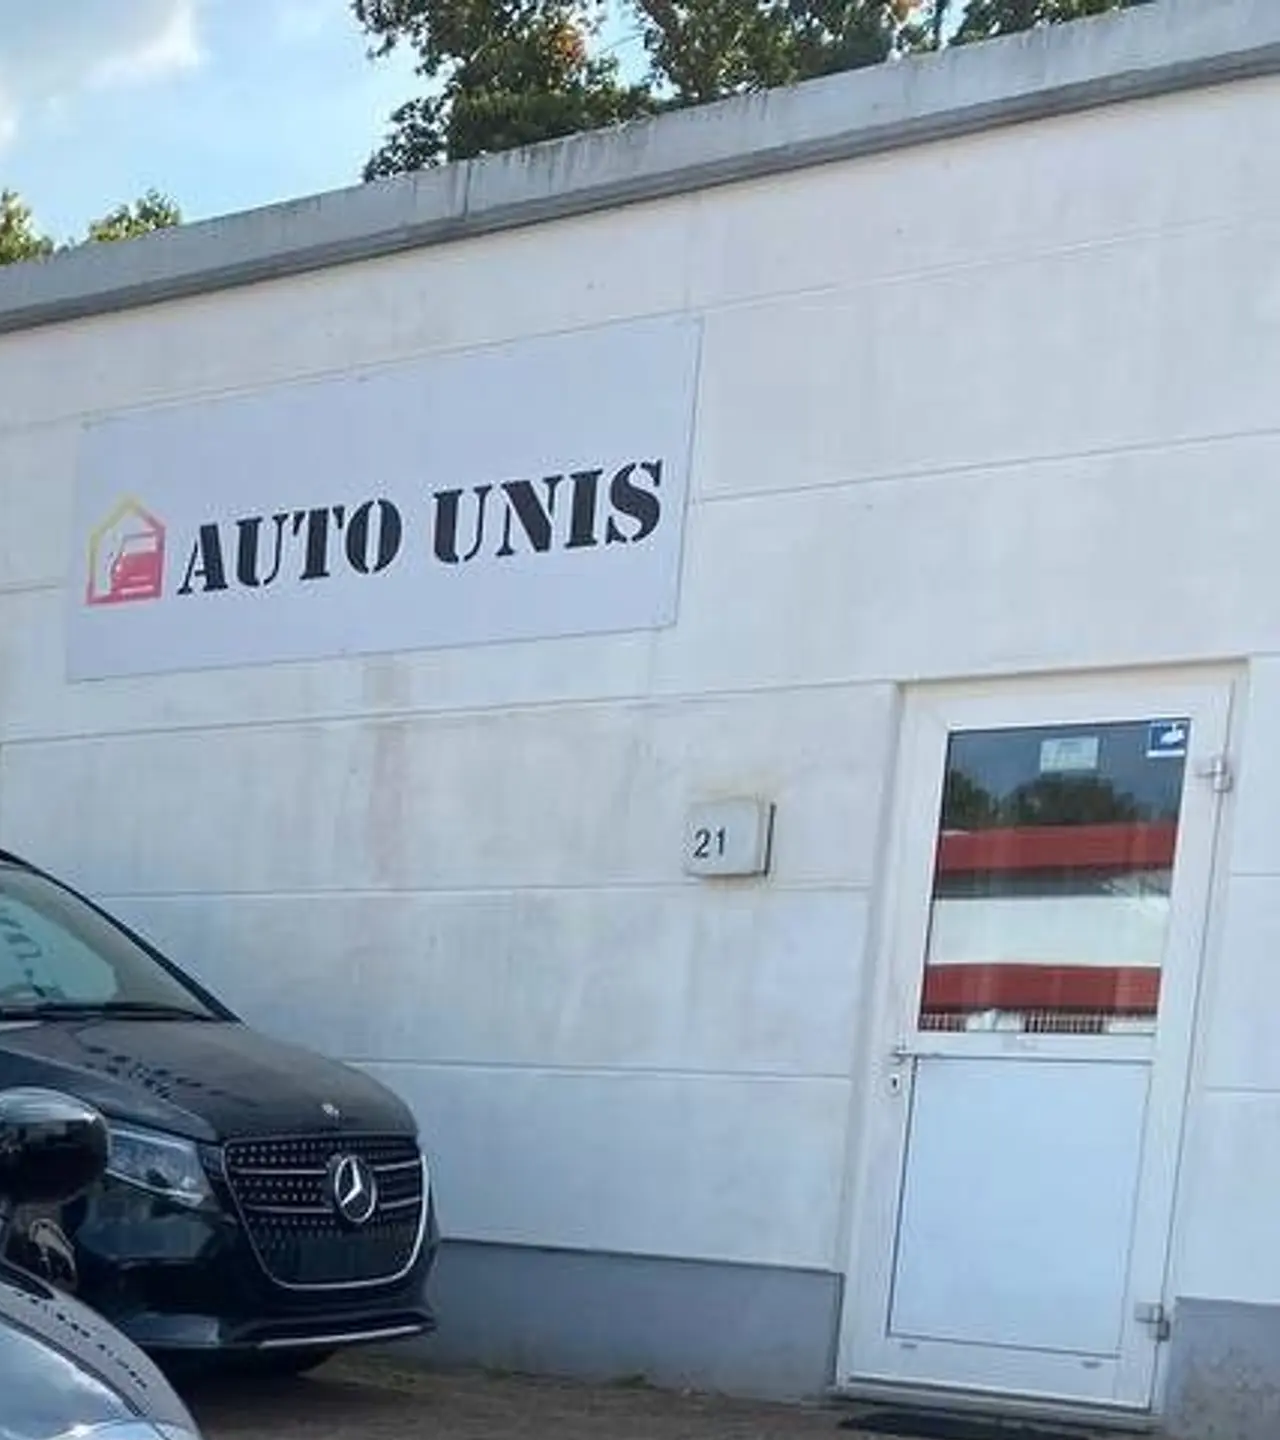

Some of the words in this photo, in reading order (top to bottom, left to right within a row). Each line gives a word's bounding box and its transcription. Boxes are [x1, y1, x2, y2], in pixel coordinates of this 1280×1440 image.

[177, 498, 403, 595] AUTO
[432, 458, 664, 564] UNIS
[693, 827, 726, 859] 21
